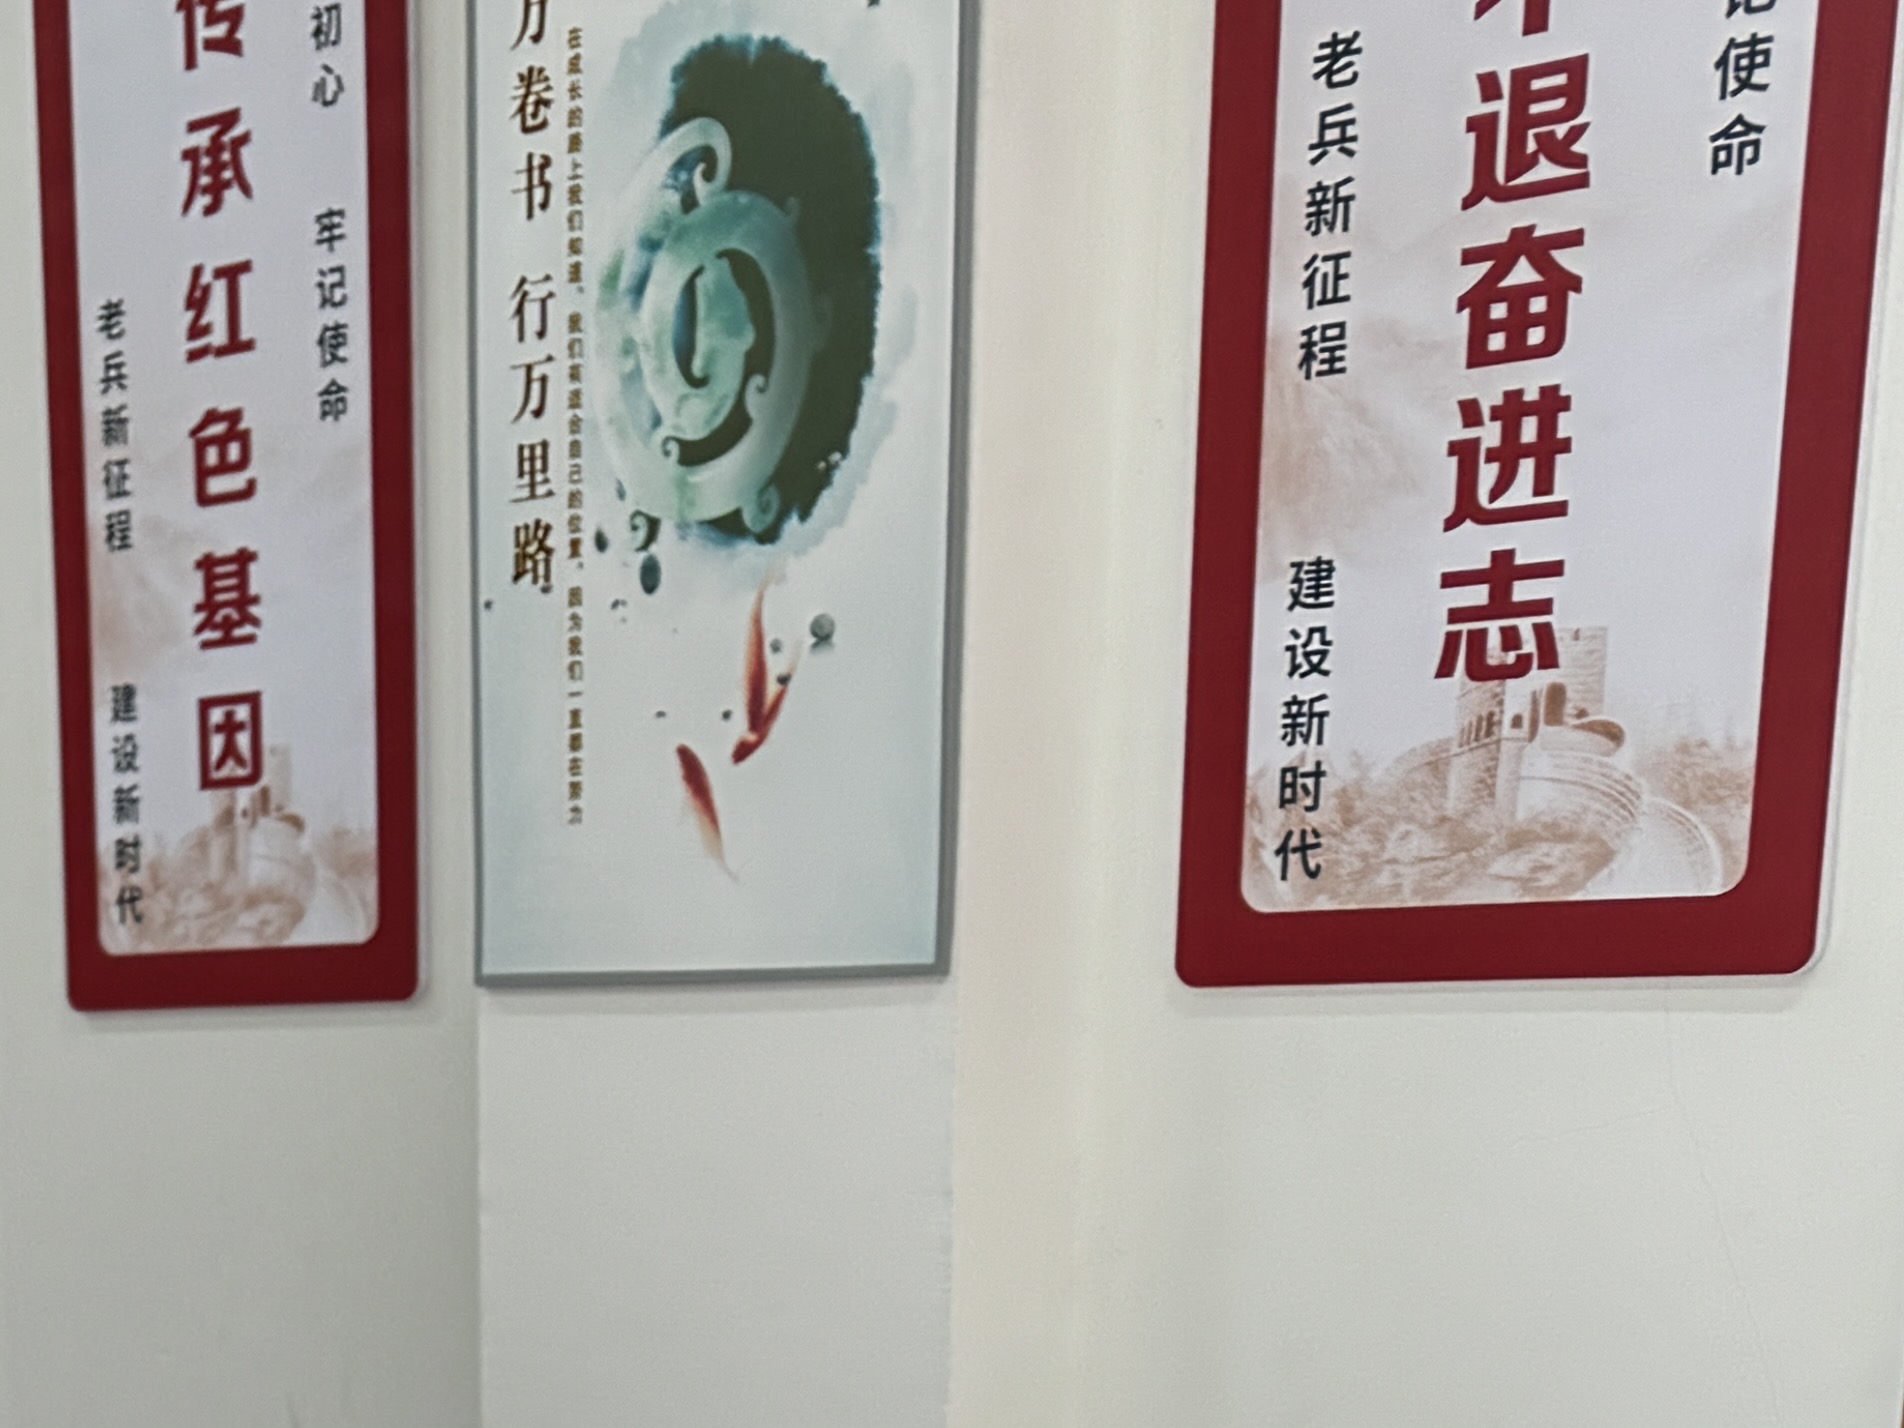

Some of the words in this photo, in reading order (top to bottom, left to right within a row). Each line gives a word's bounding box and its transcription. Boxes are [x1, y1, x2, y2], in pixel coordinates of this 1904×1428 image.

[309, 3, 345, 109] 初心
[313, 206, 351, 424] 牢记使命
[1296, 30, 1364, 382] 老兵新征程
[96, 298, 135, 554] 老兵新征程
[173, 0, 263, 791] 传承红色基因
[509, 273, 557, 590] 行万里路
[109, 683, 146, 927] 建设新时代
[1274, 556, 1338, 882] 建设新时代
